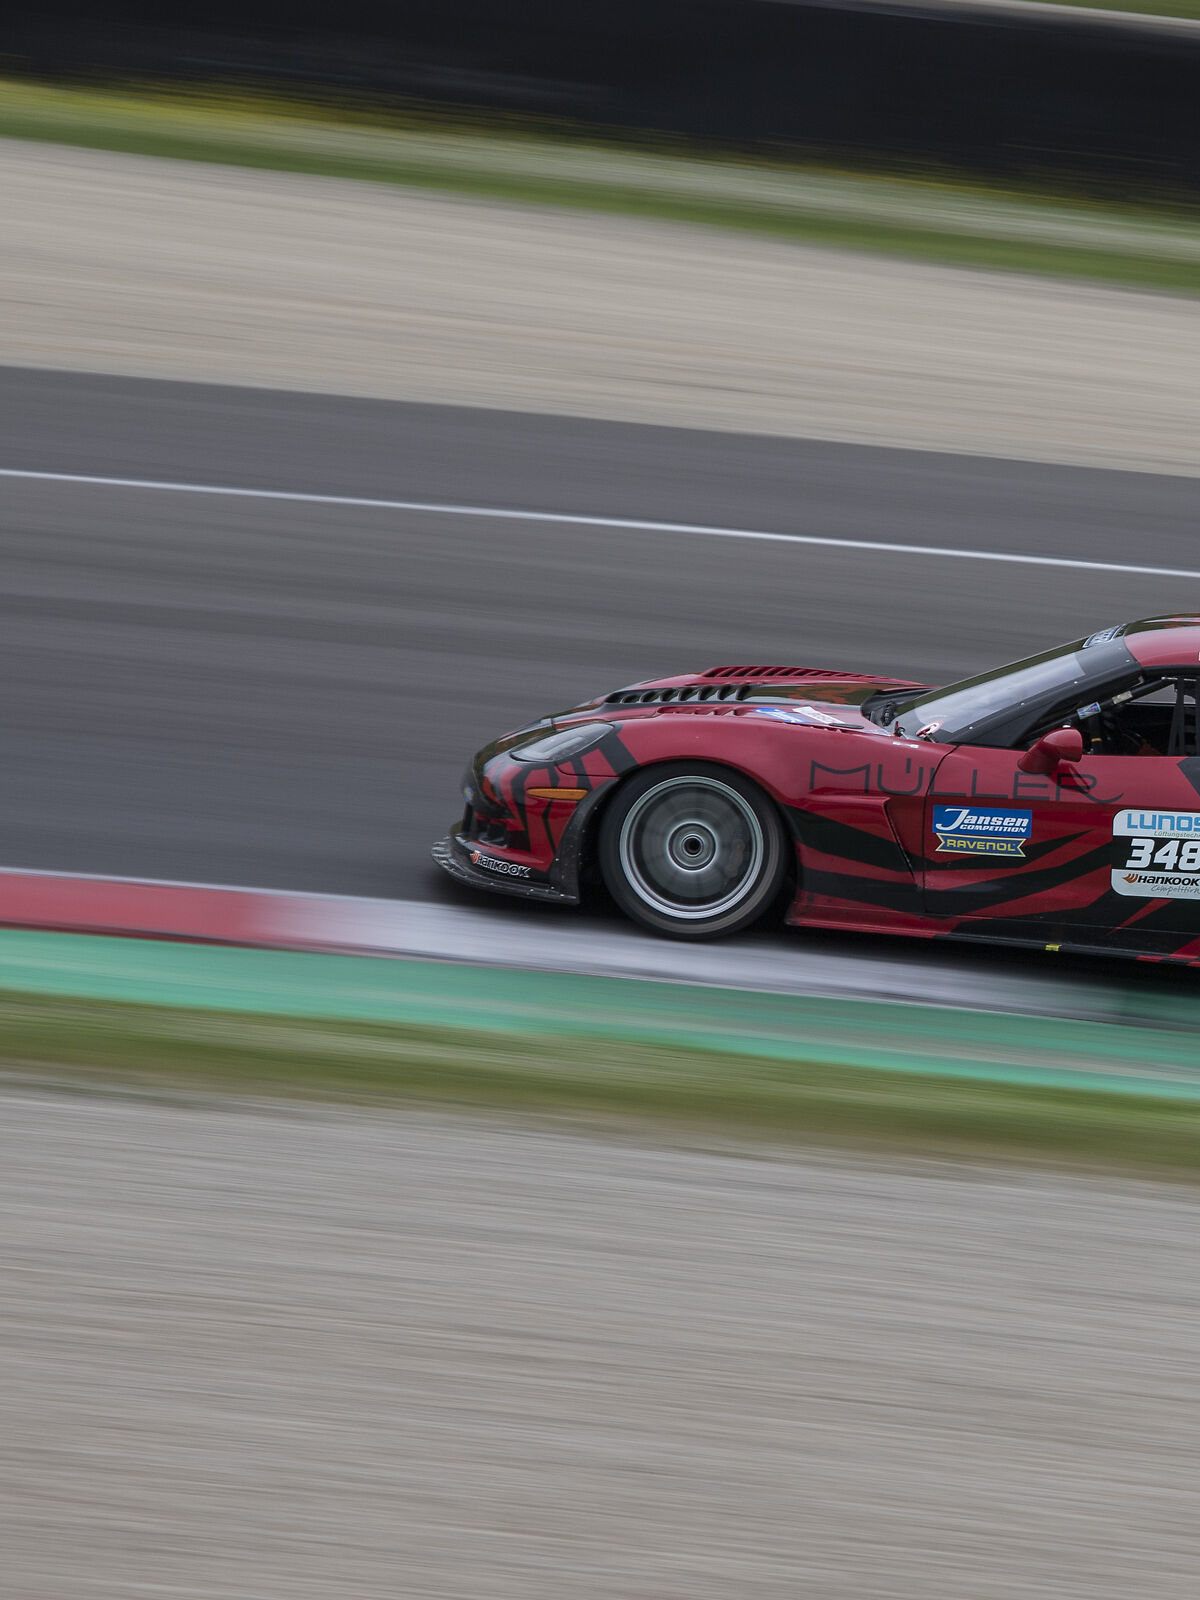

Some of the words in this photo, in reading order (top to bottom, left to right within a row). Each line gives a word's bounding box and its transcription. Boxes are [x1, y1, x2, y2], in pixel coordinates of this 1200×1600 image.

[809, 757, 1125, 804] MÜLLER
[935, 808, 1029, 831] Jansen
[959, 823, 1027, 833] COMPETITION
[946, 839, 1016, 852] RAVENOL
